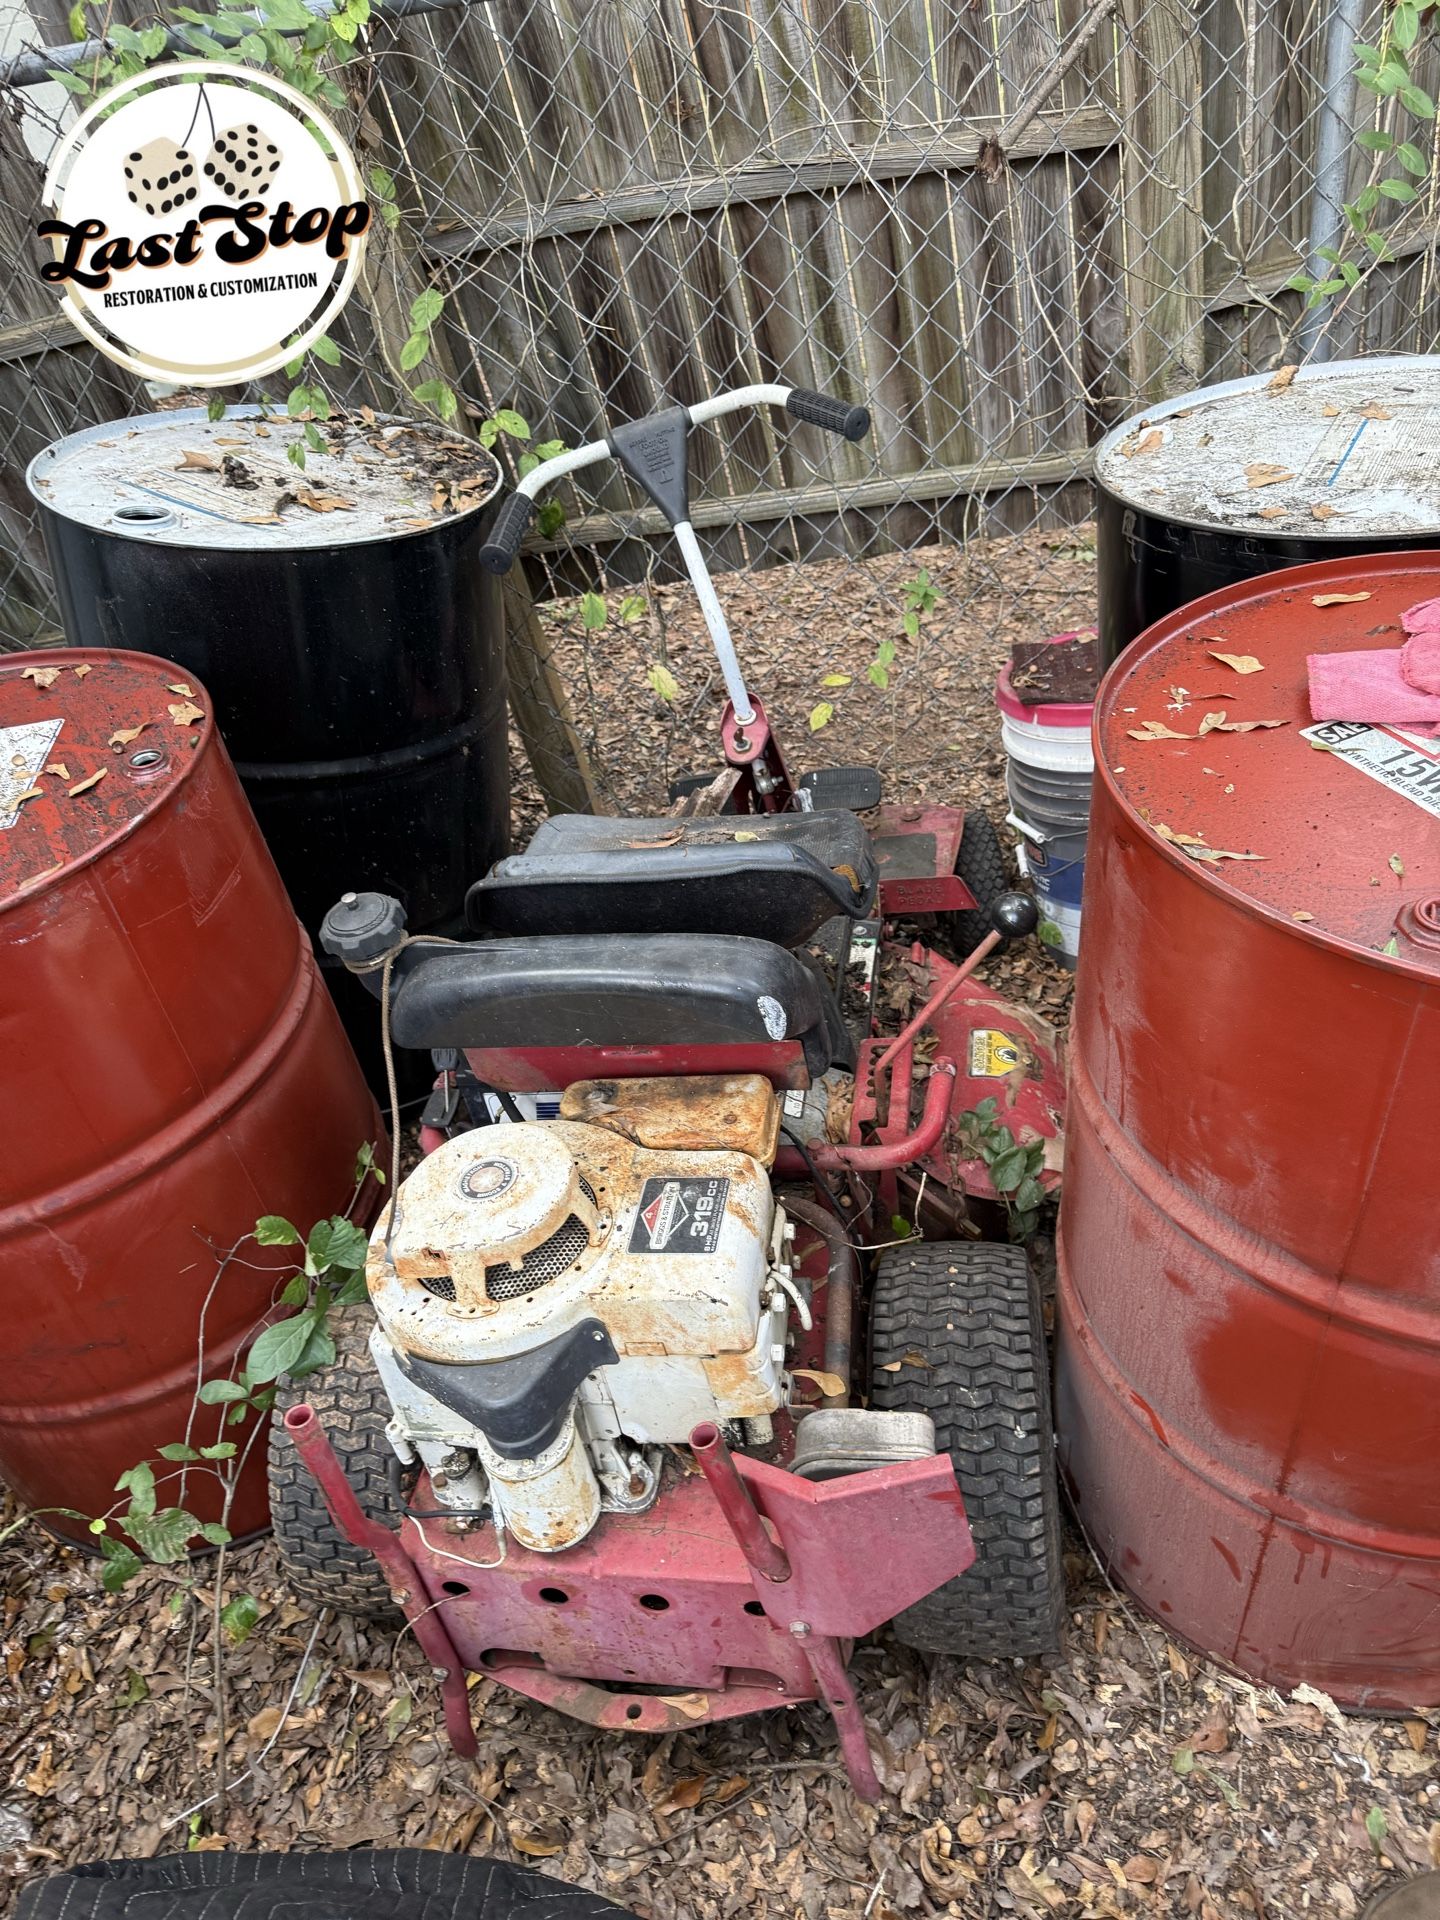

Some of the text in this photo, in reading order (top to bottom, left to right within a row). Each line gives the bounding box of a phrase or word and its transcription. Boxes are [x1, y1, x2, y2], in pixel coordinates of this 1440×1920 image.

[1341, 748, 1440, 810] SYNTHETIC BLEND DIE
[897, 884, 943, 895] BLADE
[655, 1221, 667, 1245] BRIGGS
[663, 1186, 676, 1215] STRATTON
